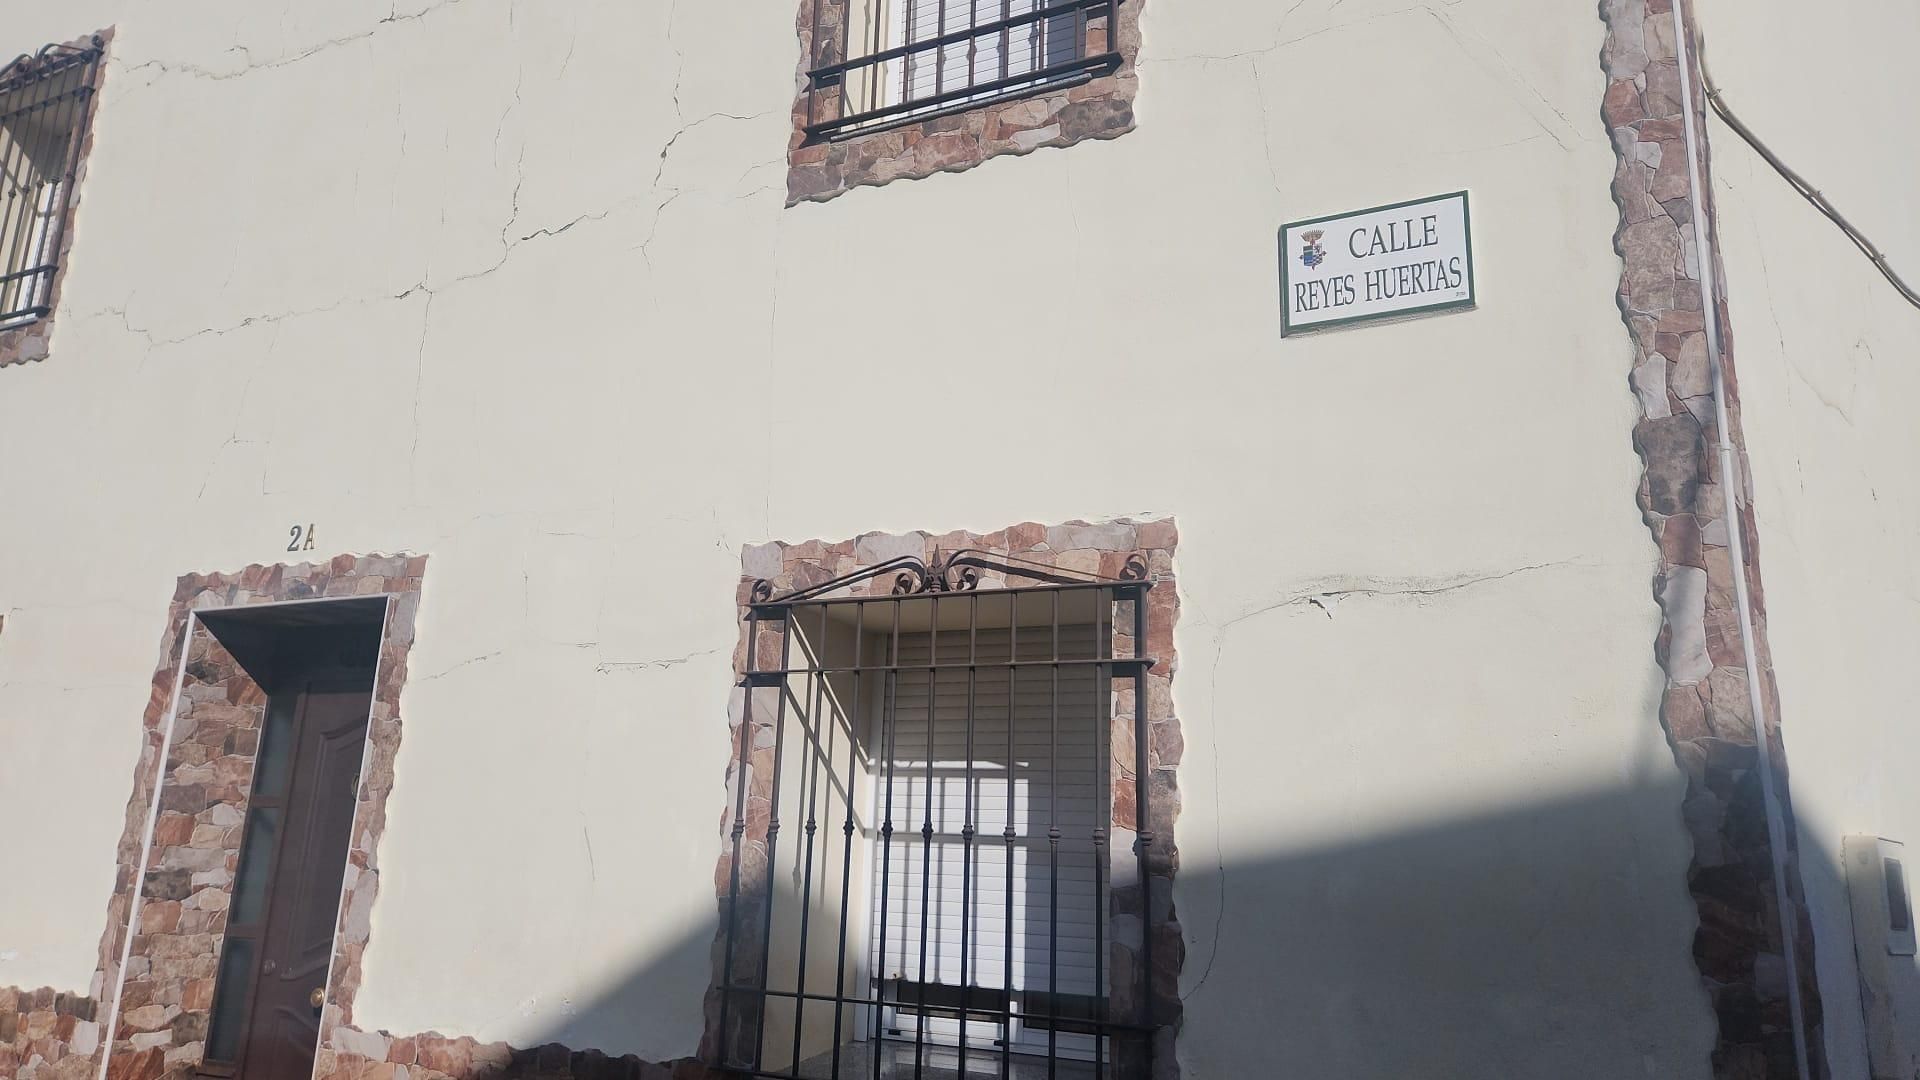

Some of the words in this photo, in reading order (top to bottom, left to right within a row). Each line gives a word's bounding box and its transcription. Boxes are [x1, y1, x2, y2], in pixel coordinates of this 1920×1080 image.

[1348, 215, 1439, 258] CALLE
[1295, 274, 1356, 312] REYES
[1364, 257, 1462, 302] HUERTAS
[287, 523, 315, 552] 2A
